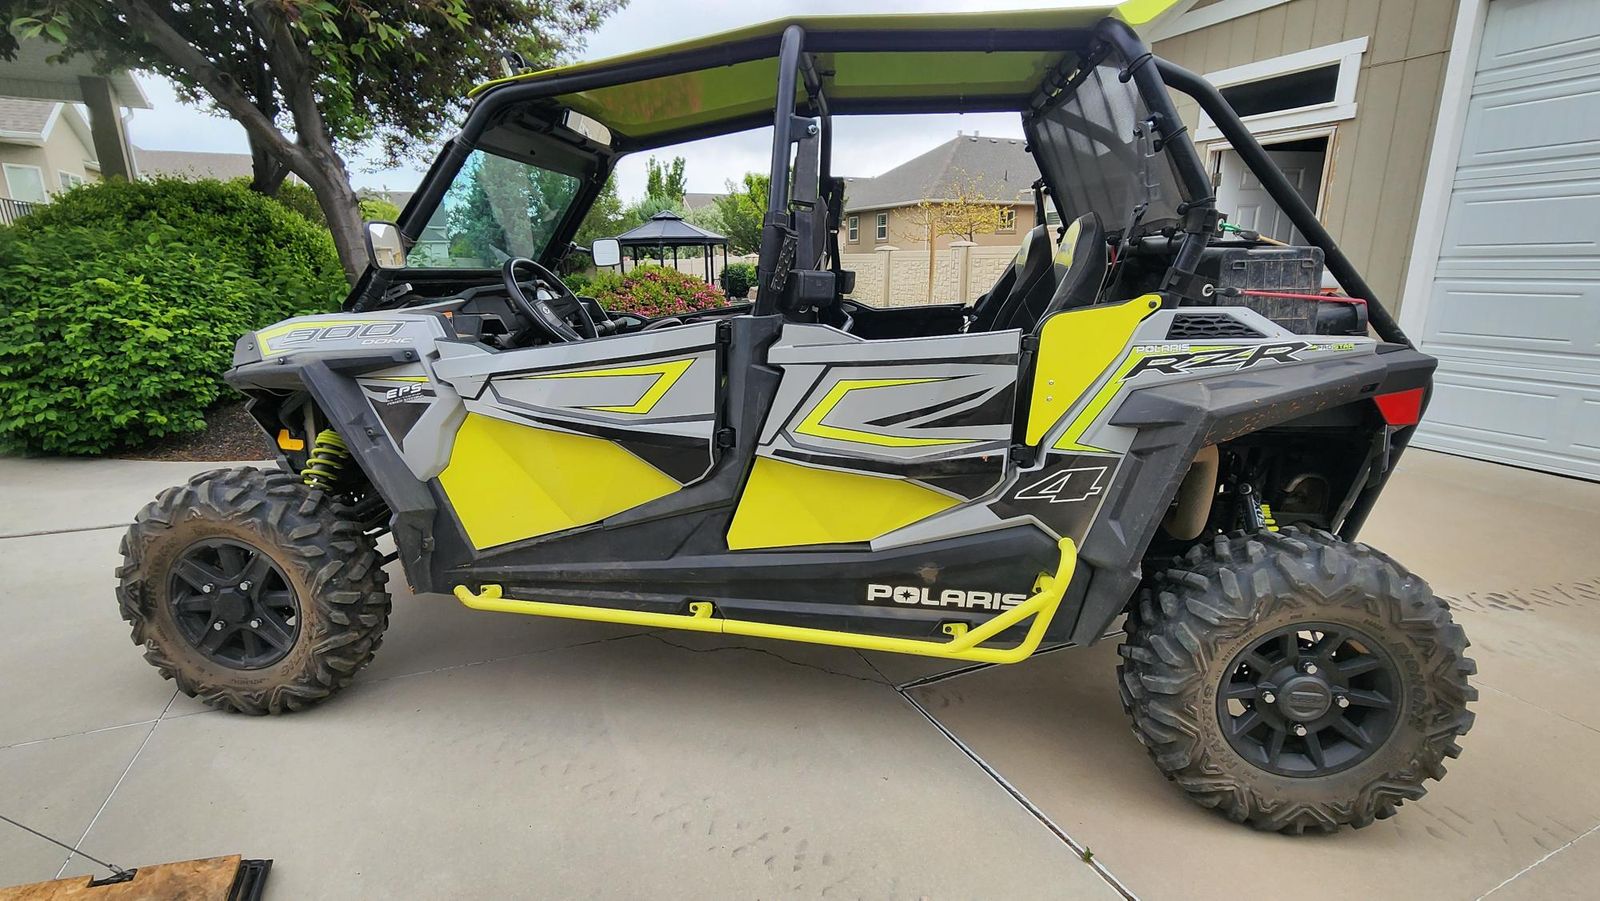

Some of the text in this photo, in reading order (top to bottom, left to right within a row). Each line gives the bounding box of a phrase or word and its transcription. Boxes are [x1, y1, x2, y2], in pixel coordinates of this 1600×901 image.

[282, 321, 406, 345] 900
[361, 337, 414, 345] DOHC
[1135, 343, 1190, 353] POLARIS
[1119, 340, 1313, 381] RZR
[386, 383, 423, 400] EPS
[1013, 466, 1108, 503] 4
[867, 583, 1027, 611] POLARIS
